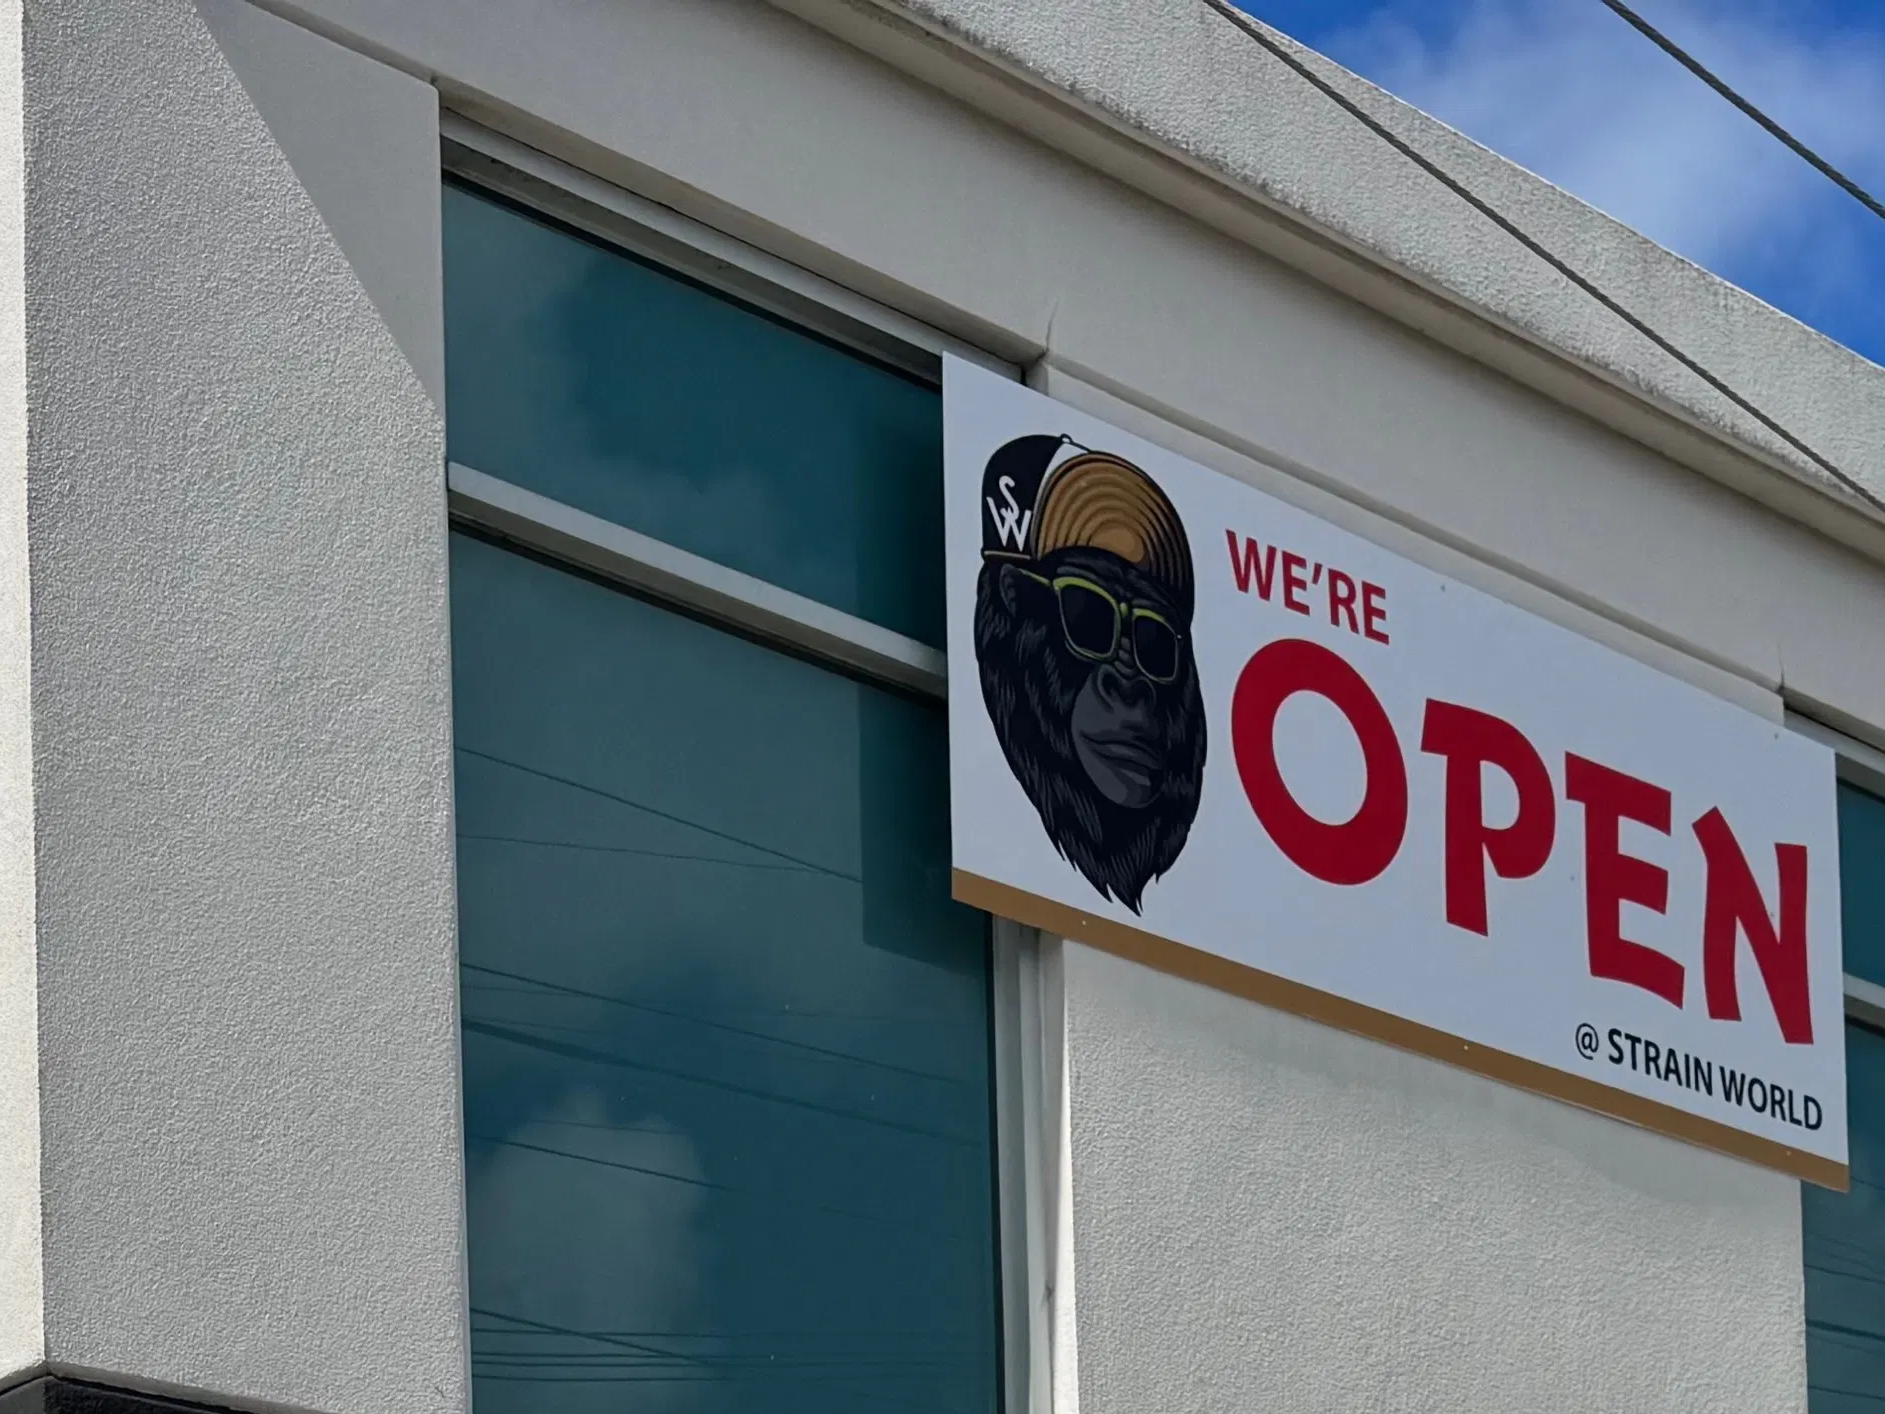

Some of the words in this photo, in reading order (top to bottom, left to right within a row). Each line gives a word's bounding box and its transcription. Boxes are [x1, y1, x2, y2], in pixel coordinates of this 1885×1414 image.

[1226, 529, 1390, 645] WE'RE
[1232, 638, 1814, 1044] OPEN
[1608, 1027, 1713, 1096] STRAIN
[1720, 1074, 1823, 1132] WORLD
